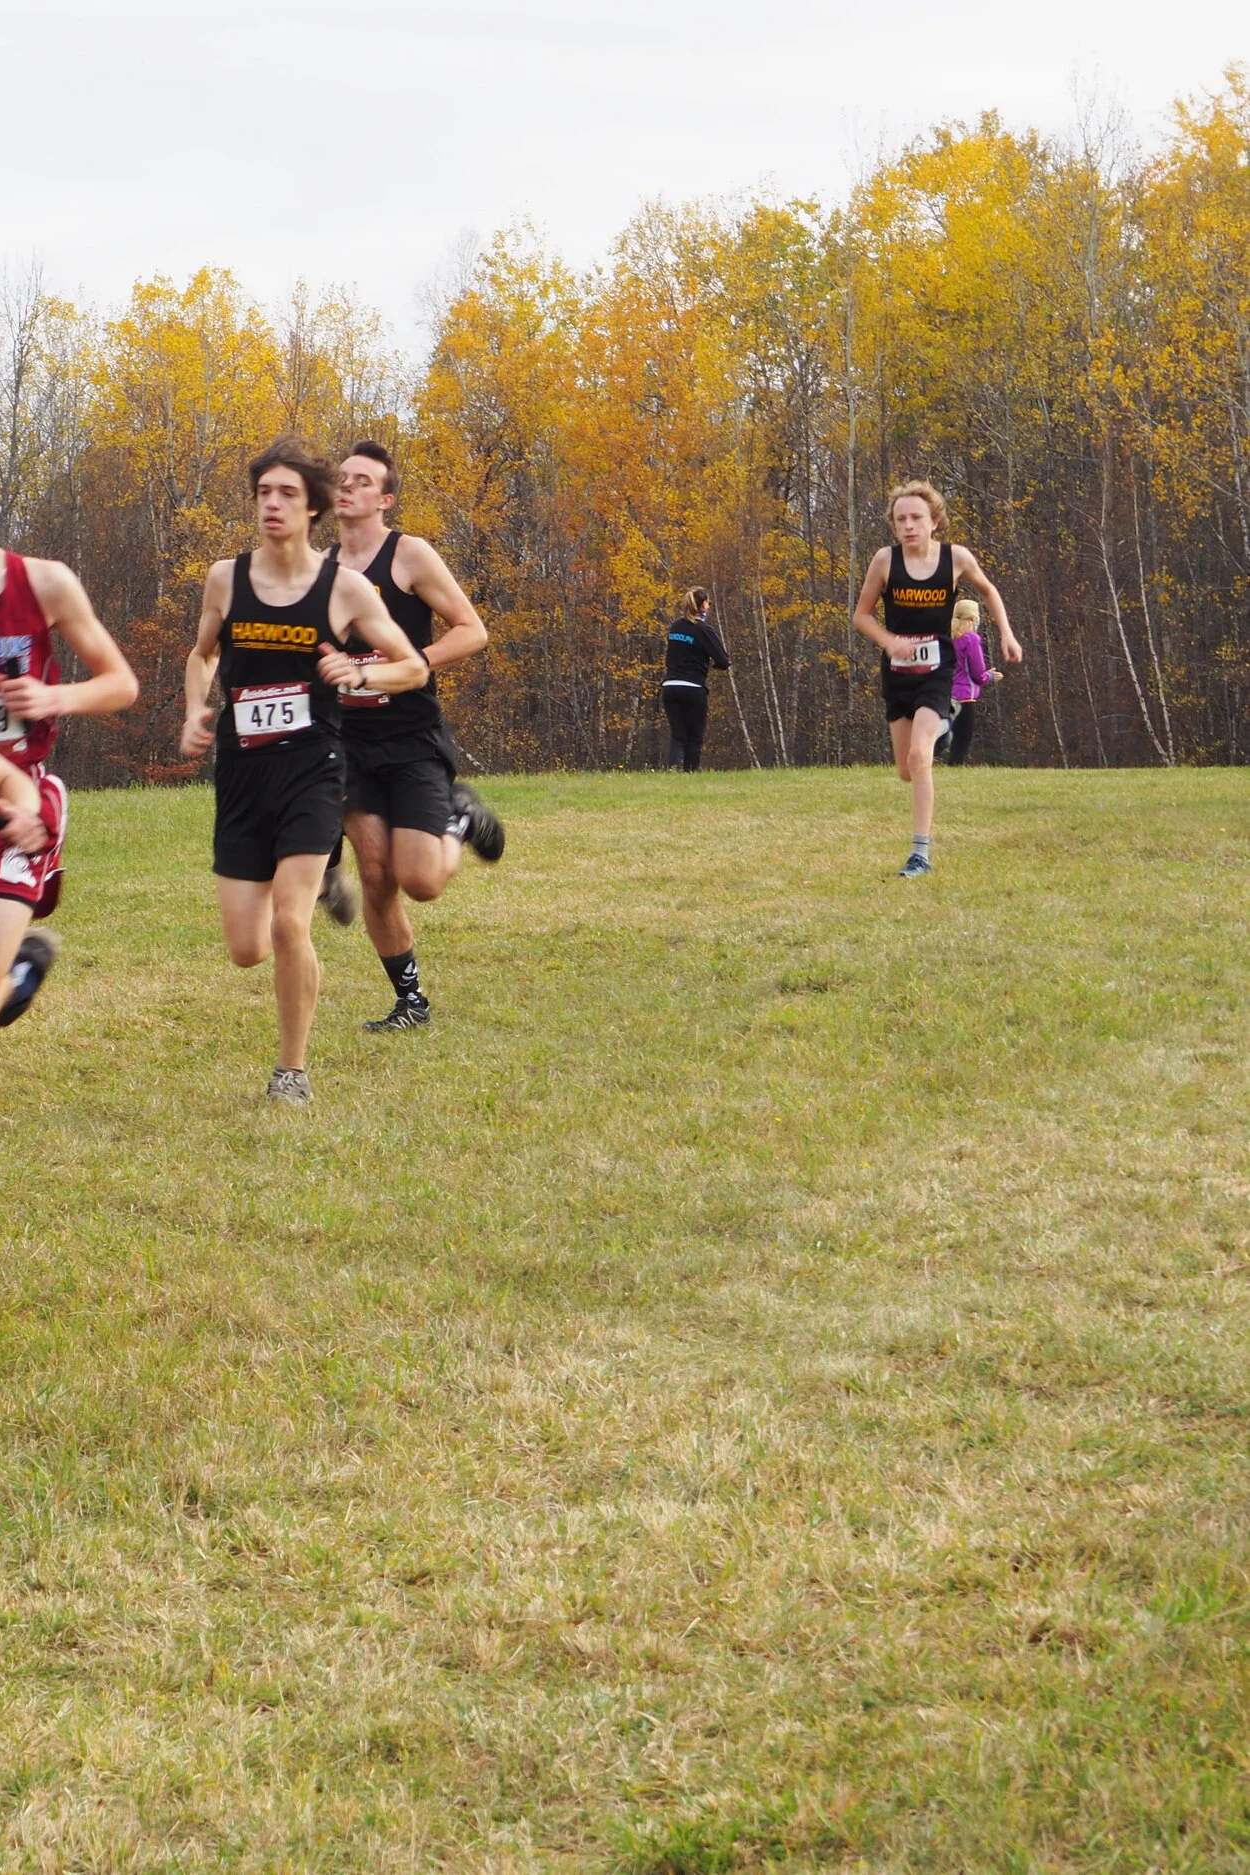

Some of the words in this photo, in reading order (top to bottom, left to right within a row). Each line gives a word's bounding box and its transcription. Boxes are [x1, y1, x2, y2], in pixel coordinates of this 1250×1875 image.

[892, 588, 947, 602] HARWOOD
[231, 622, 318, 645] HARWOOD
[347, 655, 379, 666] tic.net
[251, 701, 294, 728] 475
